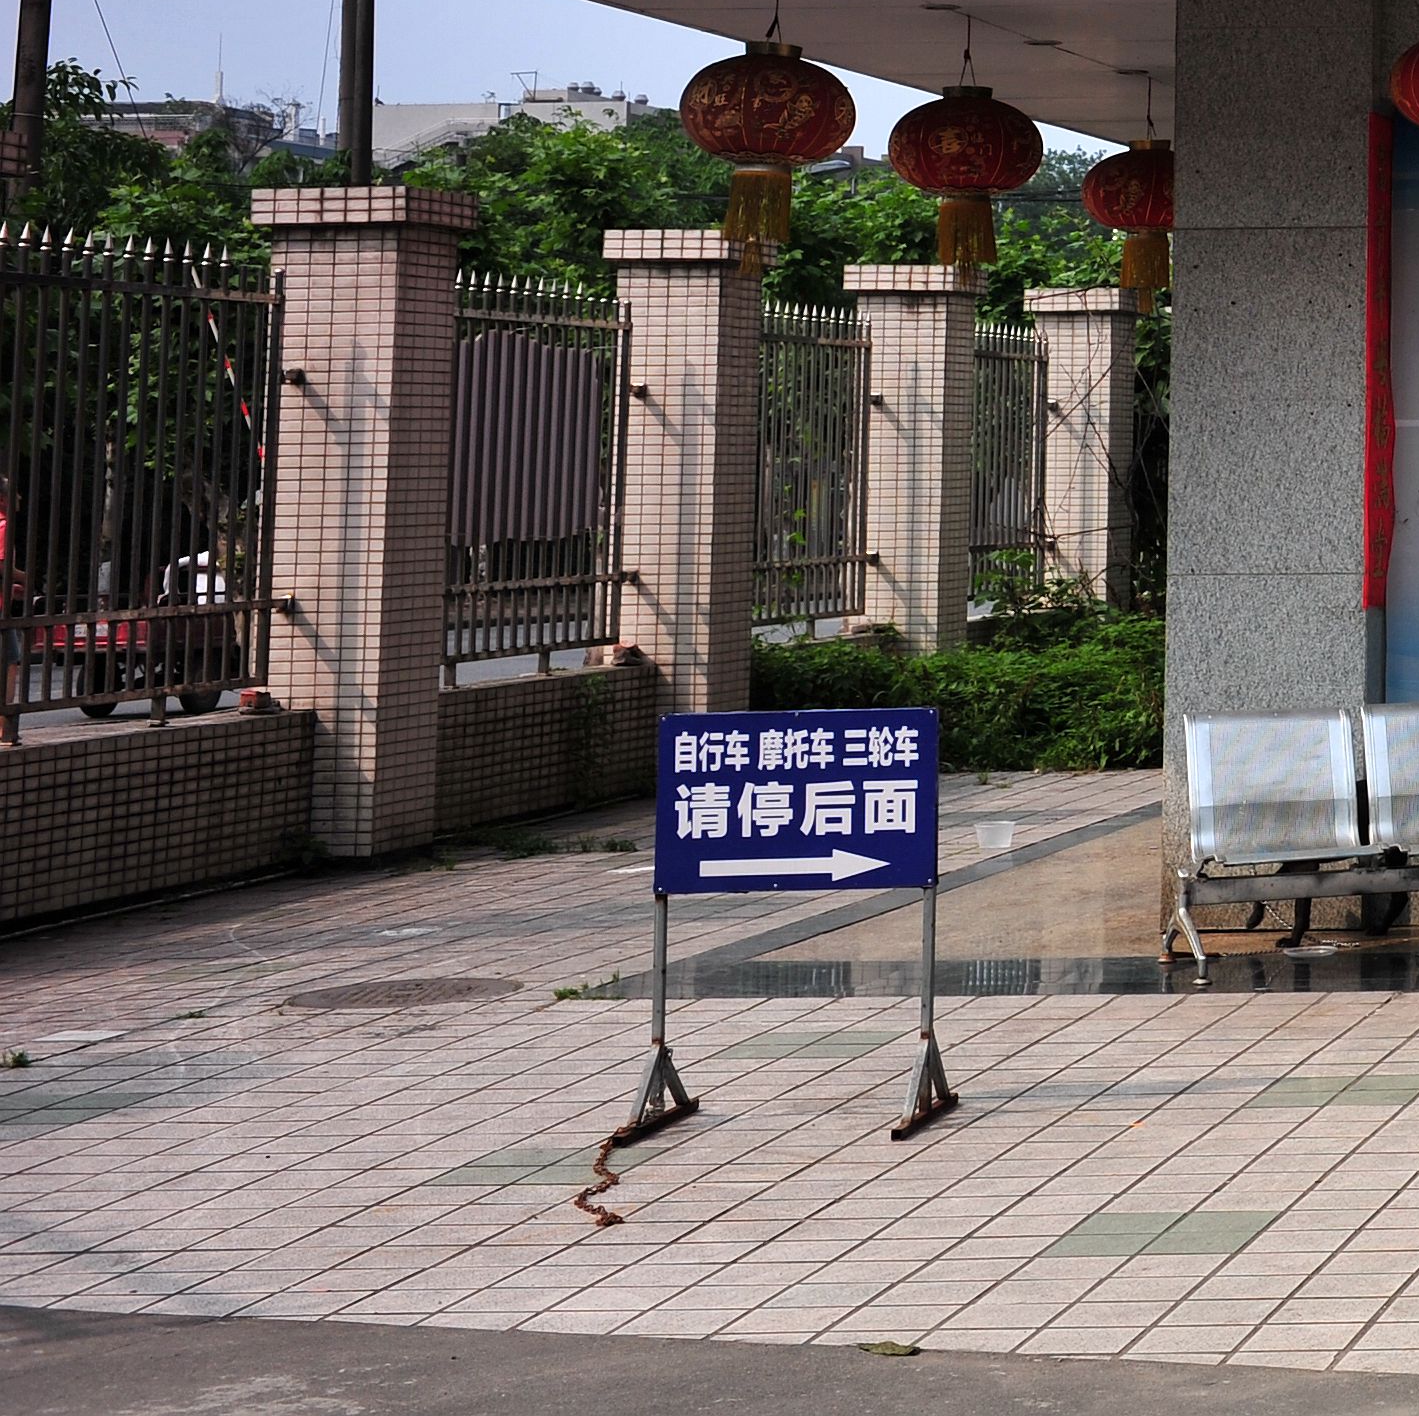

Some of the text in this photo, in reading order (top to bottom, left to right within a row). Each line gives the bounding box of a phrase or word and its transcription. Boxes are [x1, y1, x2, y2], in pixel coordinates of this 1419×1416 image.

[674, 725, 920, 774] 自行车 摩托车 三轮车
[674, 779, 919, 840] 请停后面
